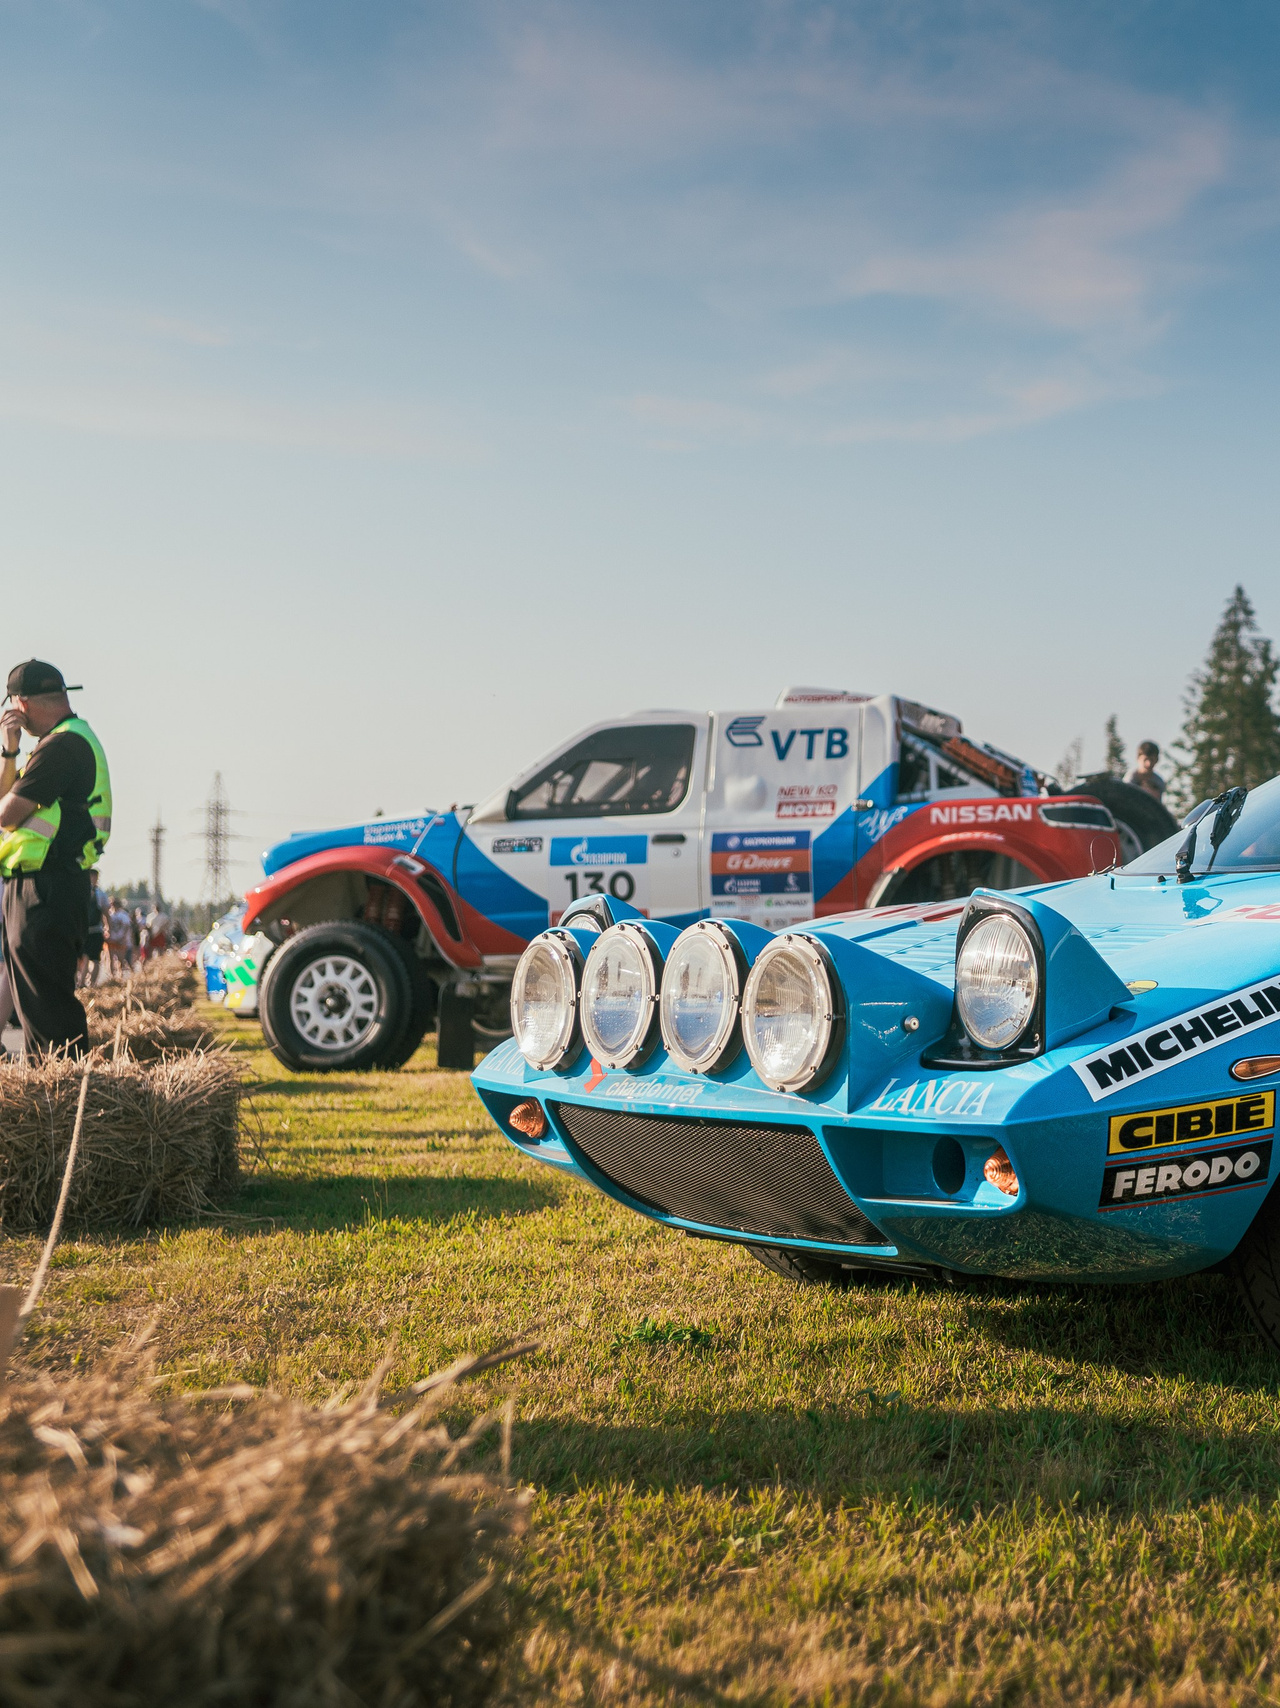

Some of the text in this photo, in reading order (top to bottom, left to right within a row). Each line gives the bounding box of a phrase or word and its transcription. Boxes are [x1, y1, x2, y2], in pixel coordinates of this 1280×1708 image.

[770, 727, 849, 760] VTB
[930, 804, 1033, 824] NISSAN
[565, 870, 635, 902] 130
[605, 1078, 705, 1103] chardonnet
[869, 1078, 994, 1115] LANCIA
[1112, 1152, 1260, 1199] FERODO
